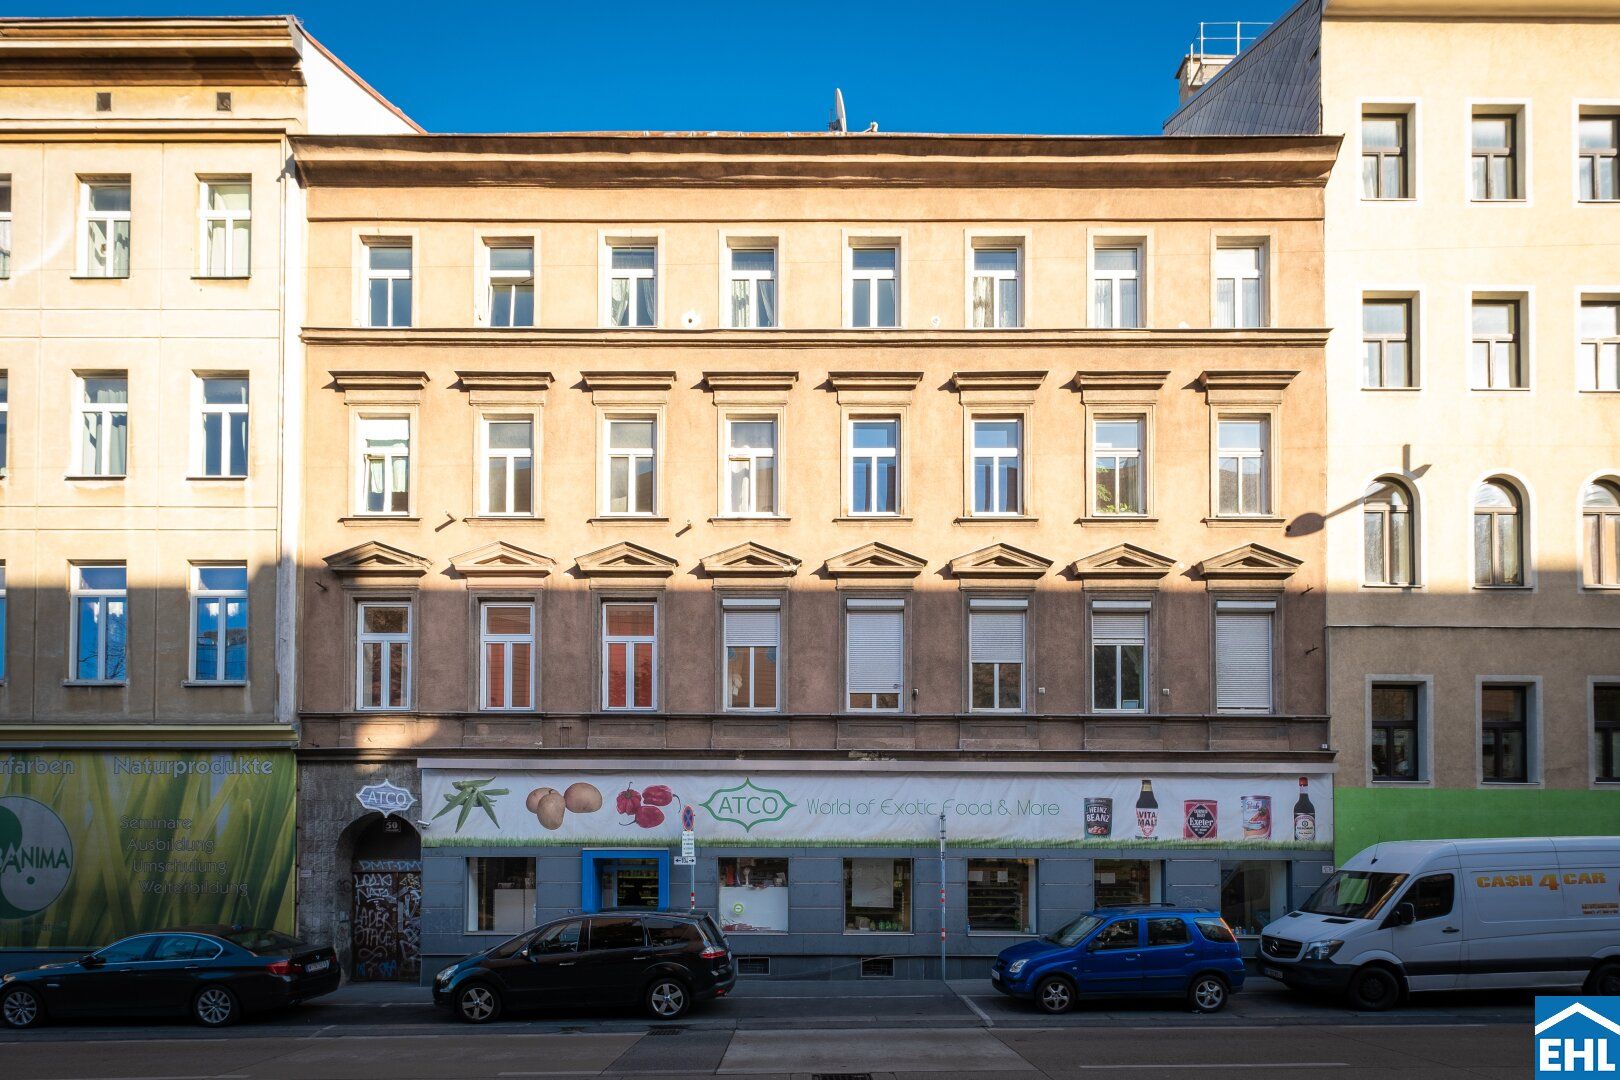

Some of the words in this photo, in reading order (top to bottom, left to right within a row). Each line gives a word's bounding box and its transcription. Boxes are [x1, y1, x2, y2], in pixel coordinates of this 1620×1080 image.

[113, 756, 273, 777] Naturprodukte
[367, 790, 407, 806] ATCO
[717, 796, 778, 814] ATCO
[807, 798, 851, 815] World
[856, 799, 876, 815] of
[880, 798, 937, 816] Exotic
[941, 798, 993, 816] Food
[997, 799, 1013, 816] &
[1017, 799, 1060, 816] More
[1089, 806, 1108, 814] HEINZ
[120, 815, 192, 829] Seminare
[384, 821, 398, 829] 50
[1086, 813, 1110, 823] BEANZ
[1189, 817, 1214, 826] Exeter
[127, 837, 215, 853] Ausbildung
[0, 842, 70, 873] ANIMA
[132, 858, 227, 876] Umschulung
[138, 879, 249, 897] Weiterbildung
[1538, 874, 1560, 890] 4
[1563, 872, 1607, 885] CAR
